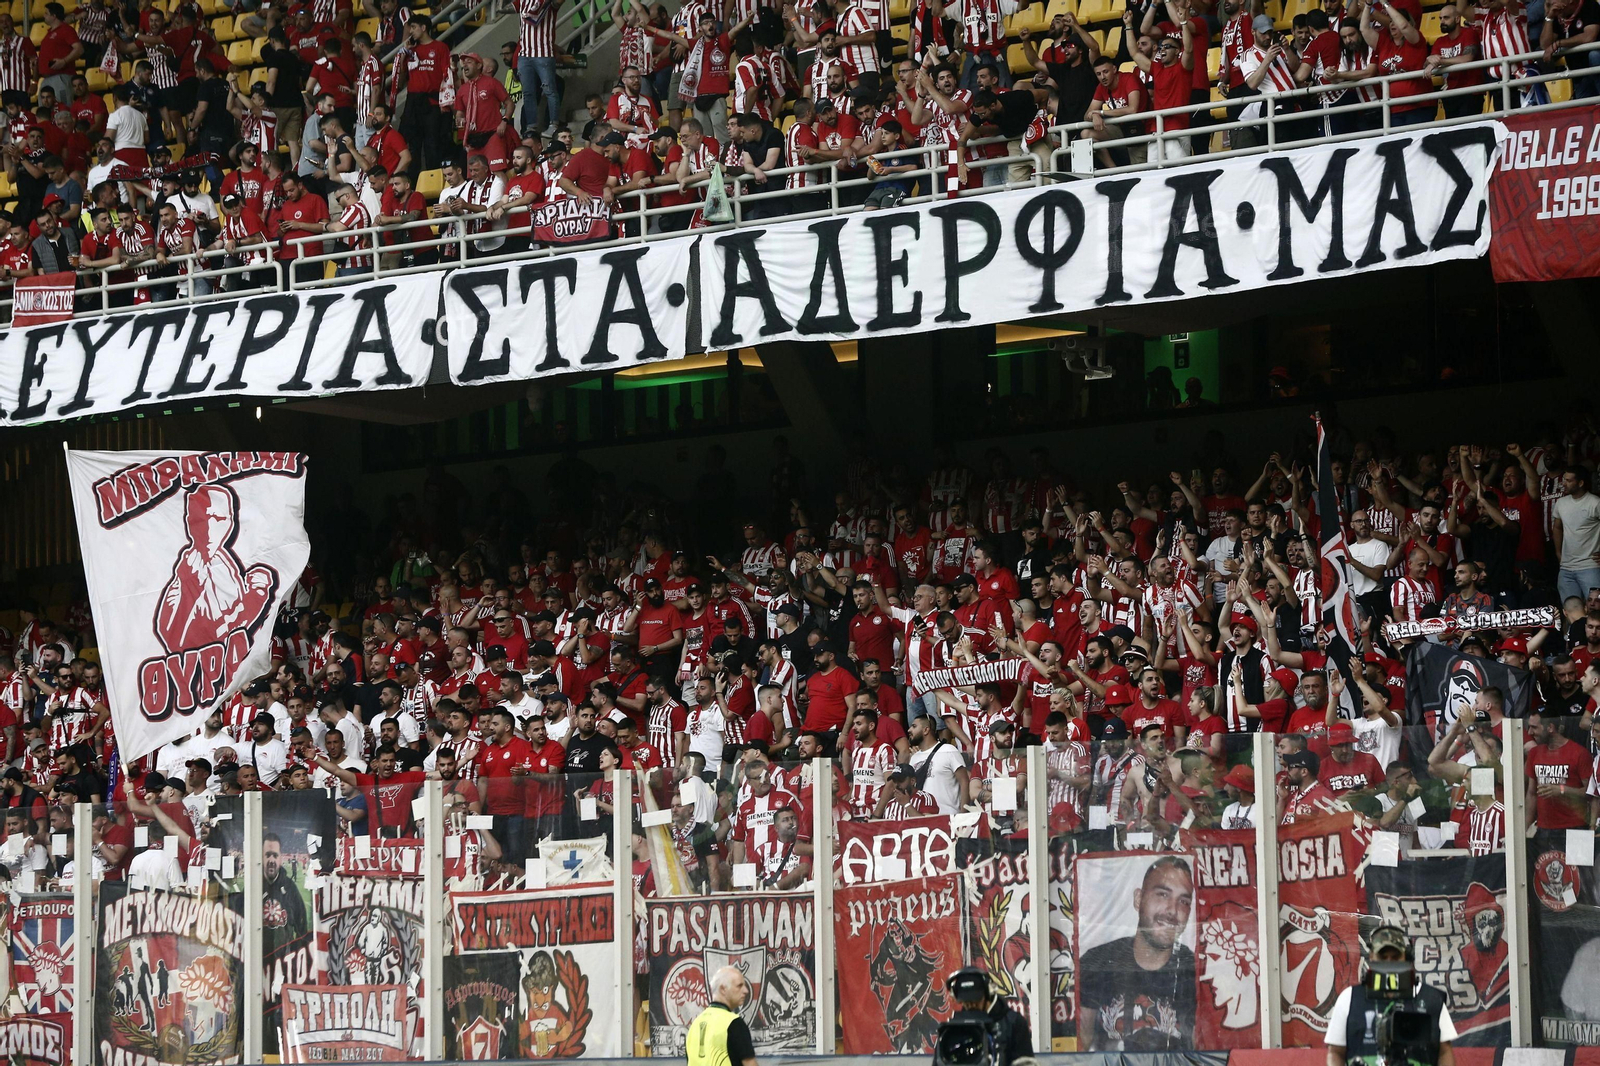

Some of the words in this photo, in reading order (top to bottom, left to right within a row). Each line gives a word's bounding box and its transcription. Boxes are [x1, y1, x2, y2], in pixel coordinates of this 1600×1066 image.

[967, 14, 996, 24] SIENS
[1500, 125, 1583, 172] DELLE
[1537, 174, 1600, 220] 1999
[554, 219, 583, 239] ΘΥΡΑ
[582, 217, 593, 234] 7
[0, 284, 413, 421] ΕΥΤΕΡΙΑ
[449, 246, 669, 383] ΣΤΑ
[710, 168, 1241, 347] ΑΔΕΡΦΙΑ
[1260, 126, 1496, 281] ΜΑΣ
[1456, 605, 1555, 631] SICKNESS
[140, 627, 252, 717] ΘΥΡΑ
[757, 819, 774, 827] mobil
[769, 855, 799, 865] SIENS
[1197, 845, 1250, 888] NEA
[848, 884, 957, 937] piraeus
[1287, 910, 1319, 932] GATE
[1376, 896, 1454, 938] RED
[767, 949, 801, 969] A.C.A.B.
[1404, 935, 1466, 972] CK
[286, 988, 397, 1032] ΤΡΙΠΟΛΗ
[341, 1047, 364, 1061] ΜΑΖΙ
[366, 1047, 384, 1060] ΣΟΥ
[474, 1031, 490, 1060] 7
